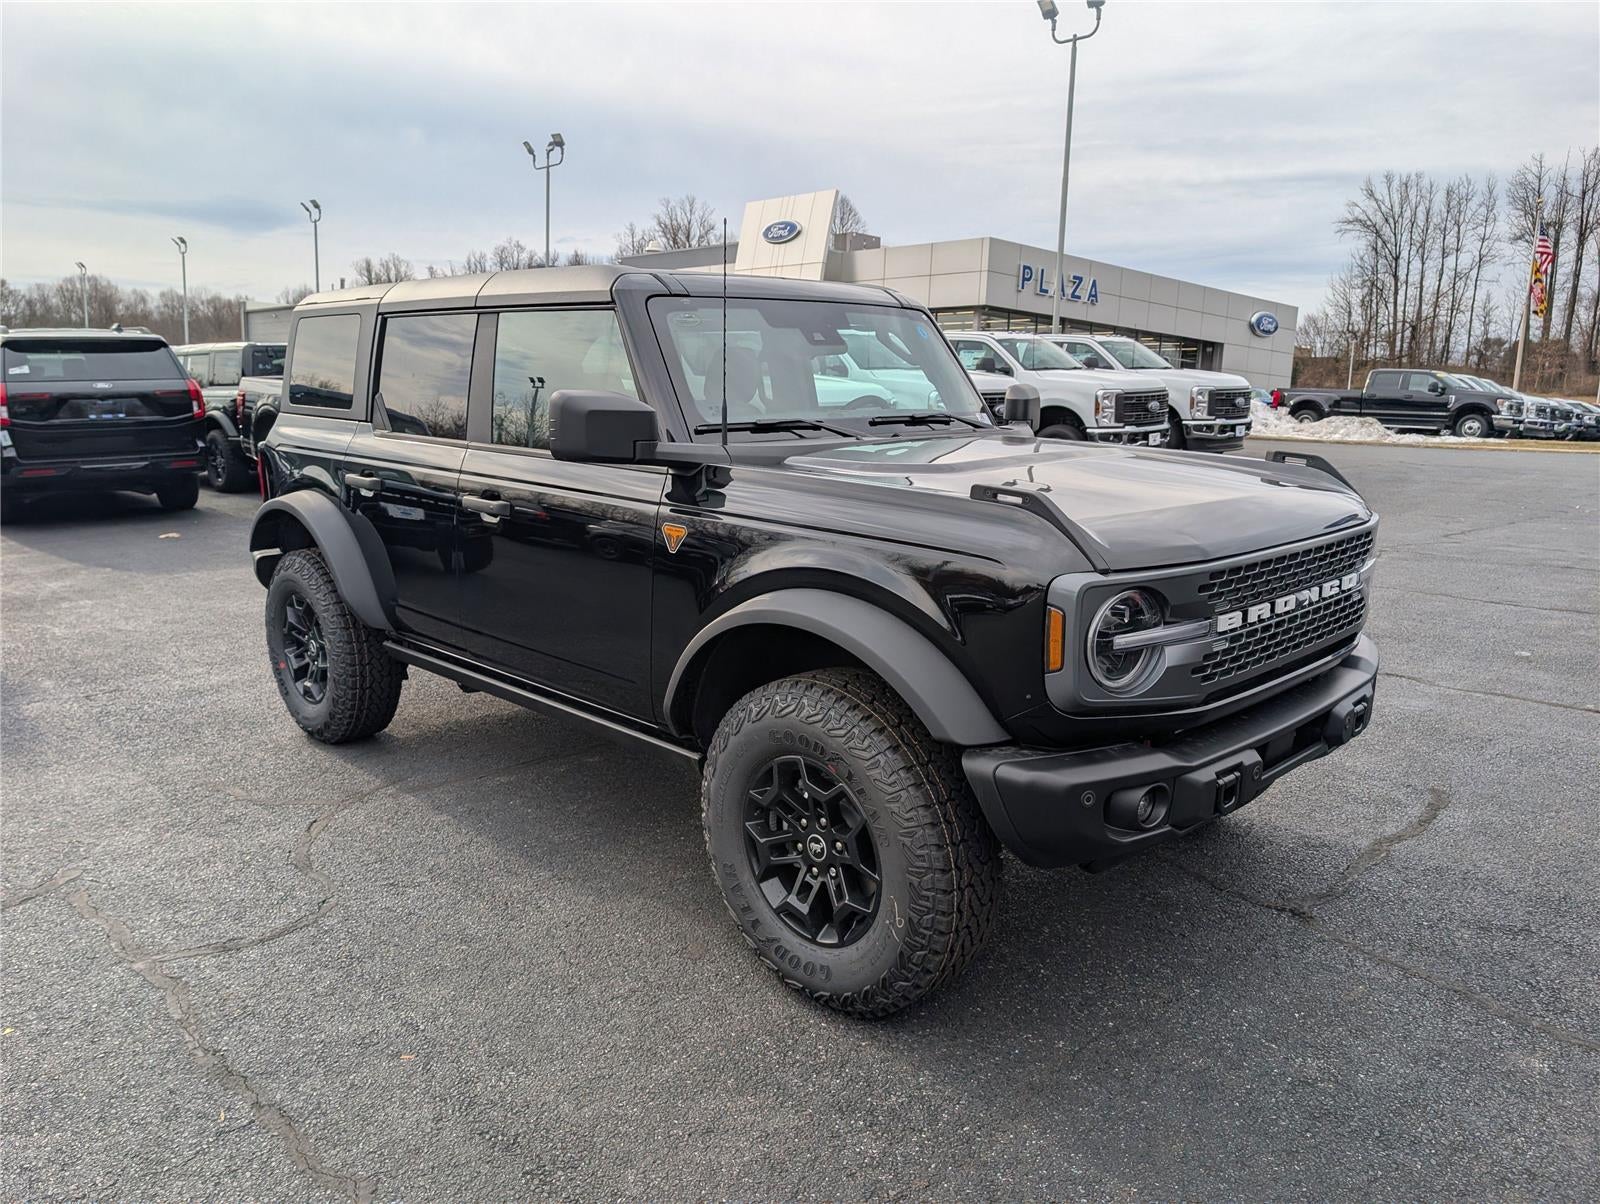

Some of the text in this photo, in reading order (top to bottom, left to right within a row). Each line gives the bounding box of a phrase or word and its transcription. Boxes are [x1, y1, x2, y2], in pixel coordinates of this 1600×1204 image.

[767, 223, 791, 238] Ford
[1260, 316, 1277, 331] Ford
[1217, 573, 1358, 633] BRONCO
